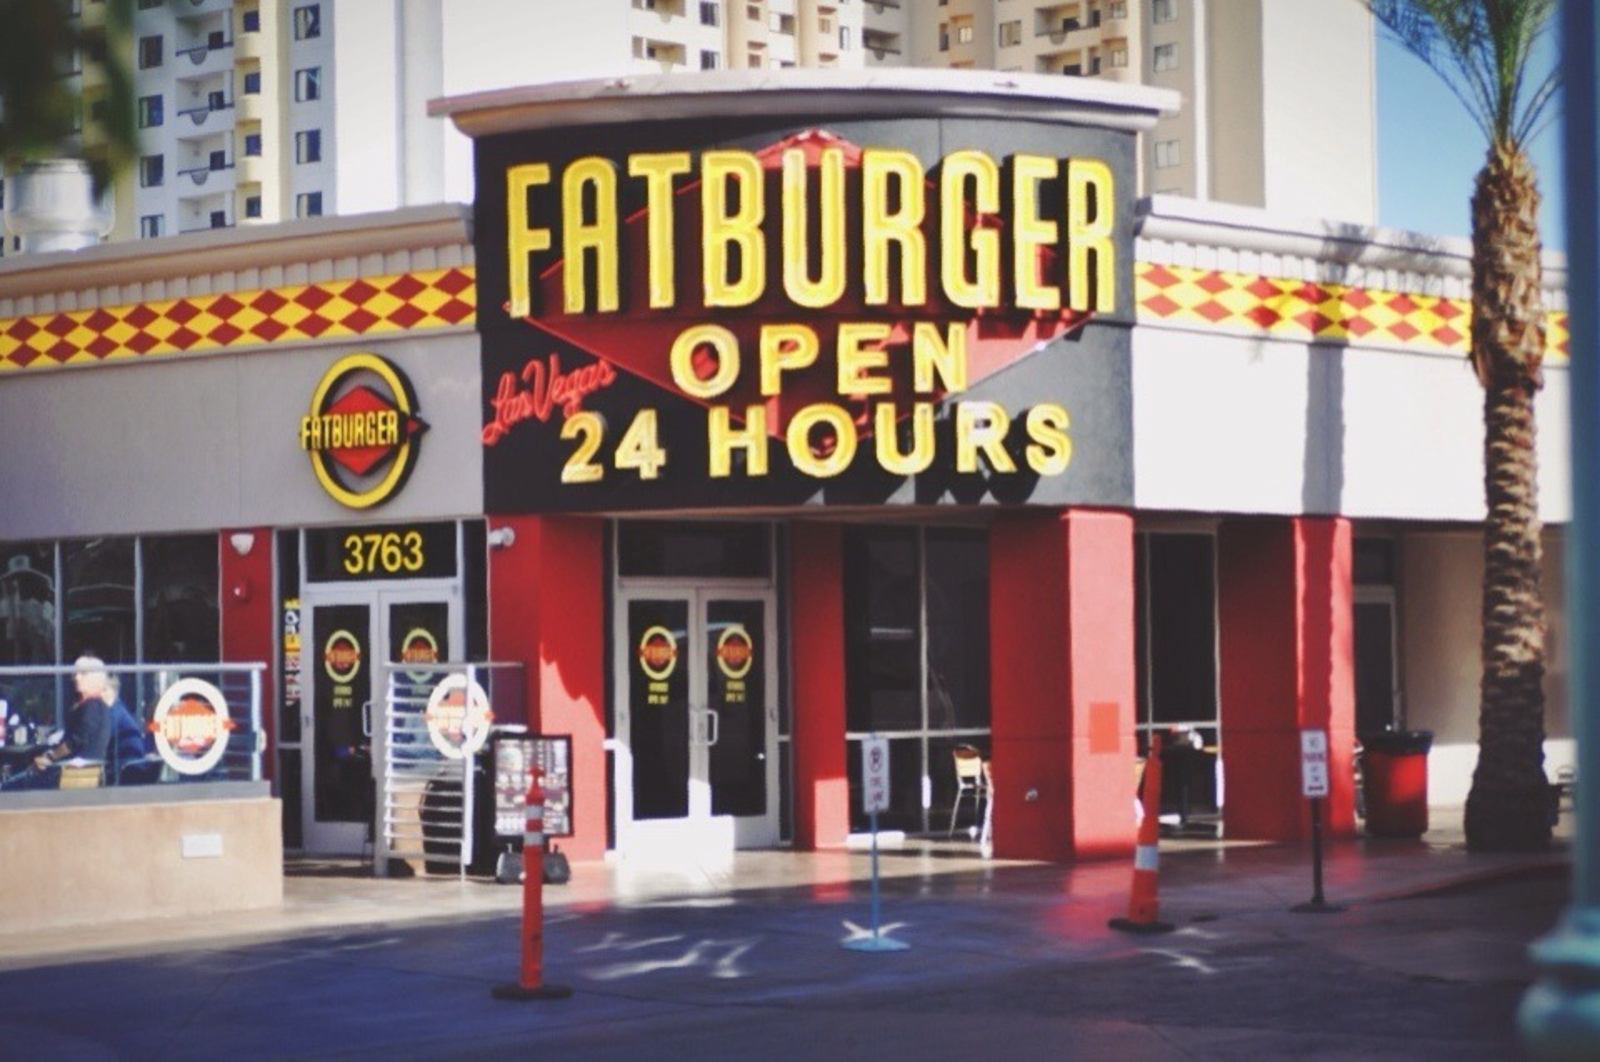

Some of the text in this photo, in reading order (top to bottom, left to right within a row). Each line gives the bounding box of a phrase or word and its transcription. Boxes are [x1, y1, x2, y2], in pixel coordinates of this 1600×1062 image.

[507, 150, 1115, 318] FATBURGER
[481, 353, 617, 445] Las Vegas
[670, 323, 967, 398] OPEN
[301, 410, 399, 449] FATBURGER
[560, 403, 1073, 483] 24 HOURS
[344, 531, 424, 574] 3763
